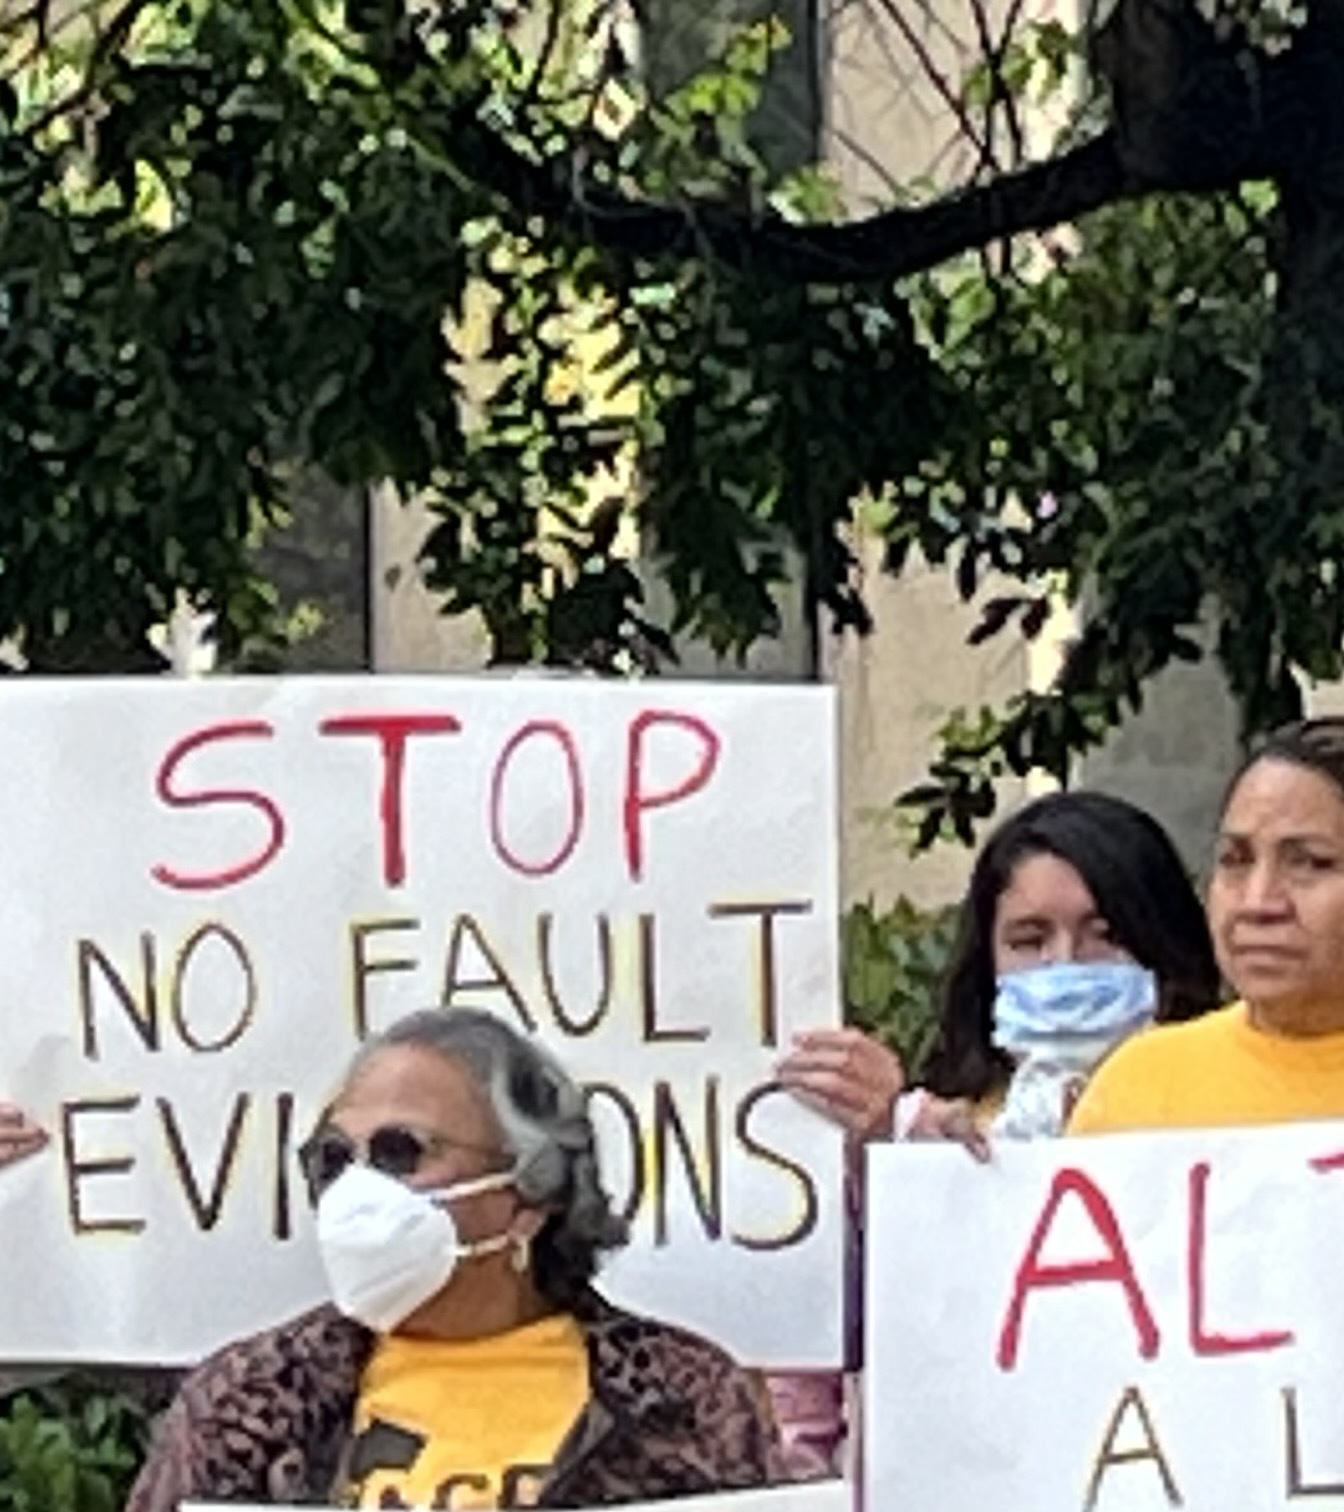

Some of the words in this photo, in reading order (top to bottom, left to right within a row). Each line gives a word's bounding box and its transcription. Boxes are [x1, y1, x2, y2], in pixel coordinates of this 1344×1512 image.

[151, 709, 722, 891] STOP
[77, 921, 258, 1060] NO
[349, 899, 814, 1048] FAULT
